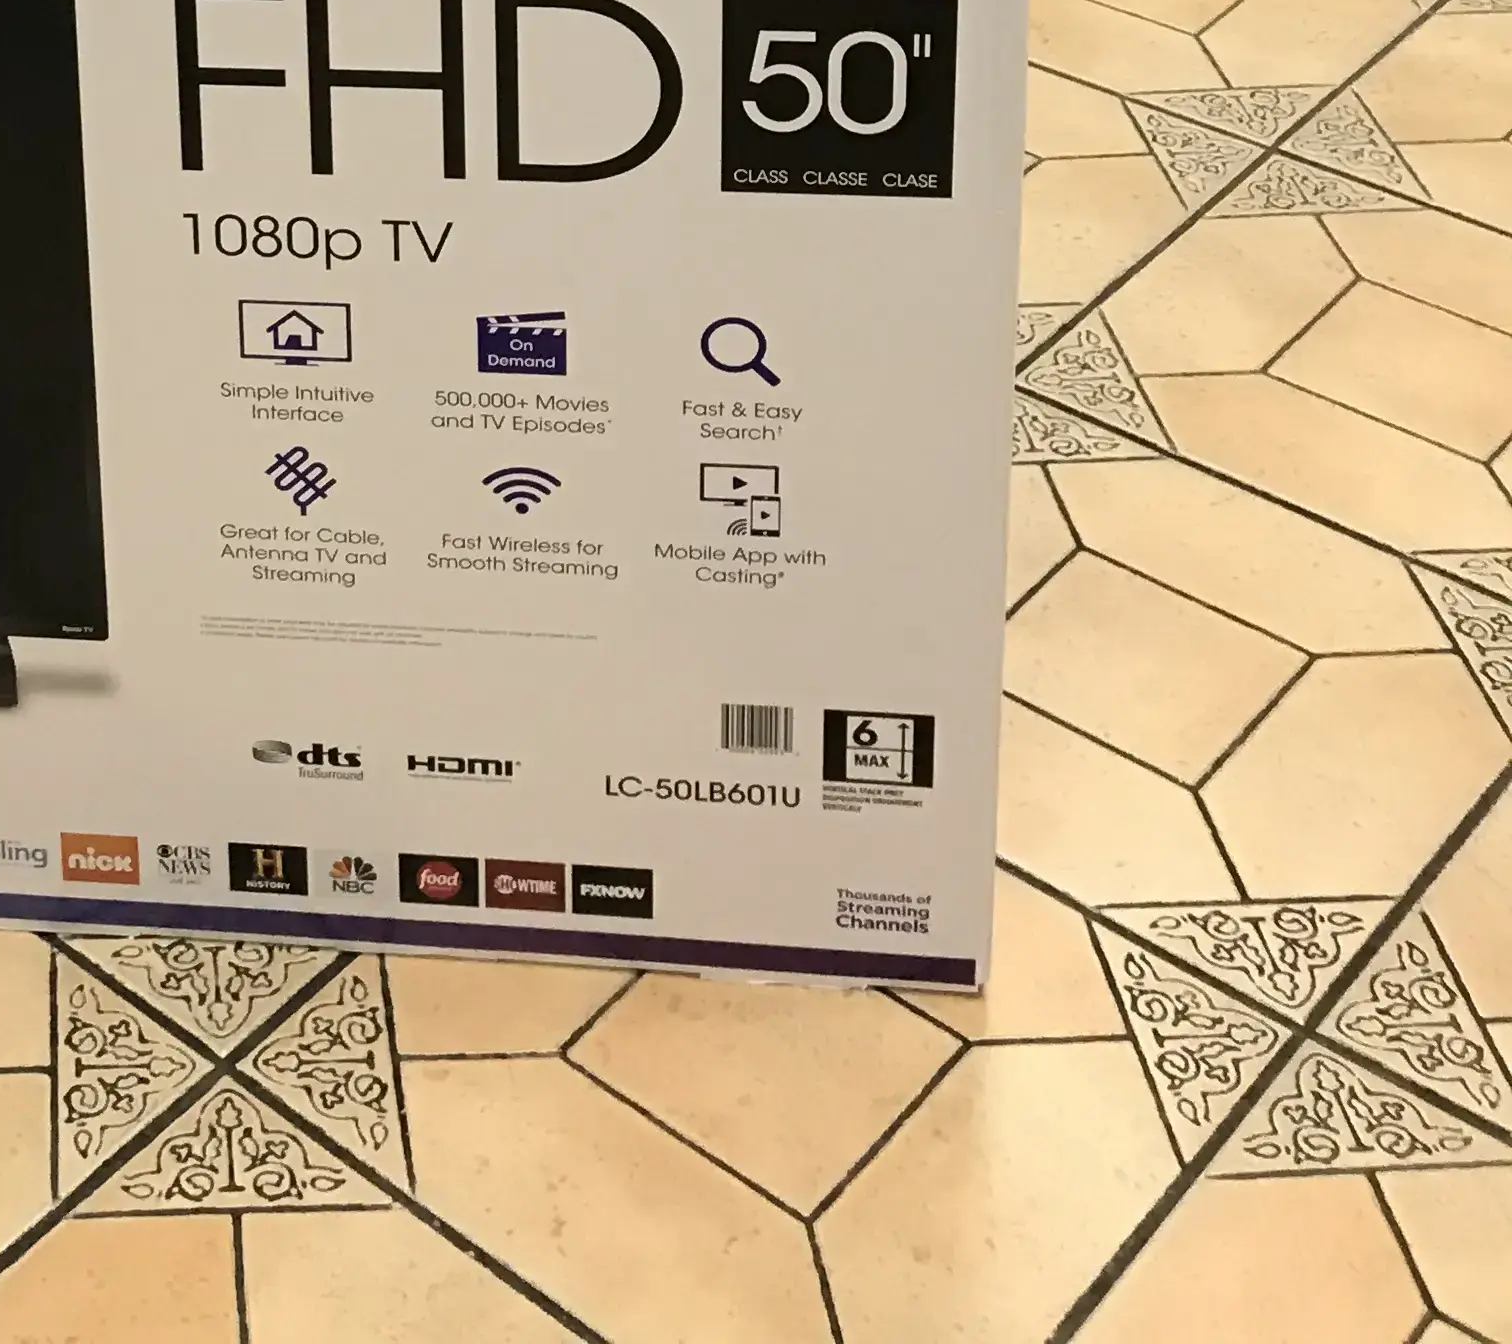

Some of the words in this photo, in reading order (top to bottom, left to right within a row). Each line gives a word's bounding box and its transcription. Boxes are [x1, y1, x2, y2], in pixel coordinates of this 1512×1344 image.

[740, 29, 932, 135] 50"
[733, 168, 790, 186] CLASS
[802, 170, 868, 188] CLASSE
[881, 171, 938, 190] CLASE
[181, 212, 362, 271] 1080p
[381, 218, 454, 264] TV
[509, 337, 534, 353] On
[487, 353, 557, 370] Demand
[220, 382, 290, 405] Simple
[295, 385, 375, 404] Intuitive
[434, 390, 529, 412] 500,000+
[535, 394, 610, 414] Movies
[251, 404, 344, 423] Interface
[430, 412, 474, 431] and
[478, 413, 507, 431] TV
[682, 400, 724, 419] Fast
[730, 402, 747, 420] &
[754, 403, 803, 425] Easy
[219, 524, 278, 545] Great
[284, 525, 312, 544] for
[316, 527, 385, 548] Cable,
[441, 533, 484, 552] Fast
[489, 535, 570, 555] Wireless
[575, 538, 605, 556] for
[220, 543, 308, 564] Antenna
[311, 547, 338, 564] TV
[343, 548, 387, 567] and
[426, 552, 507, 572] Smooth
[511, 557, 619, 580] Streaming
[654, 543, 726, 563] Mobile
[731, 547, 779, 569] App
[784, 548, 826, 567] with
[251, 566, 356, 589] Streaming
[852, 719, 879, 747] 6
[296, 742, 362, 768] dts
[407, 754, 513, 777] HDMI
[853, 753, 890, 768] MAX
[298, 767, 364, 782] TruSurround
[605, 774, 801, 809] LC-50LB601U
[67, 849, 133, 874] nick
[172, 844, 211, 861] CBS
[255, 848, 284, 879] H
[157, 858, 211, 877] NEWS
[415, 867, 463, 891] food
[245, 879, 291, 891] HISTORY
[331, 879, 375, 895] NBC
[579, 883, 646, 901] FXNOW
[837, 888, 913, 904] Thousands
[916, 893, 932, 905] of
[837, 901, 930, 921] Streaming
[836, 913, 930, 933] Channels
